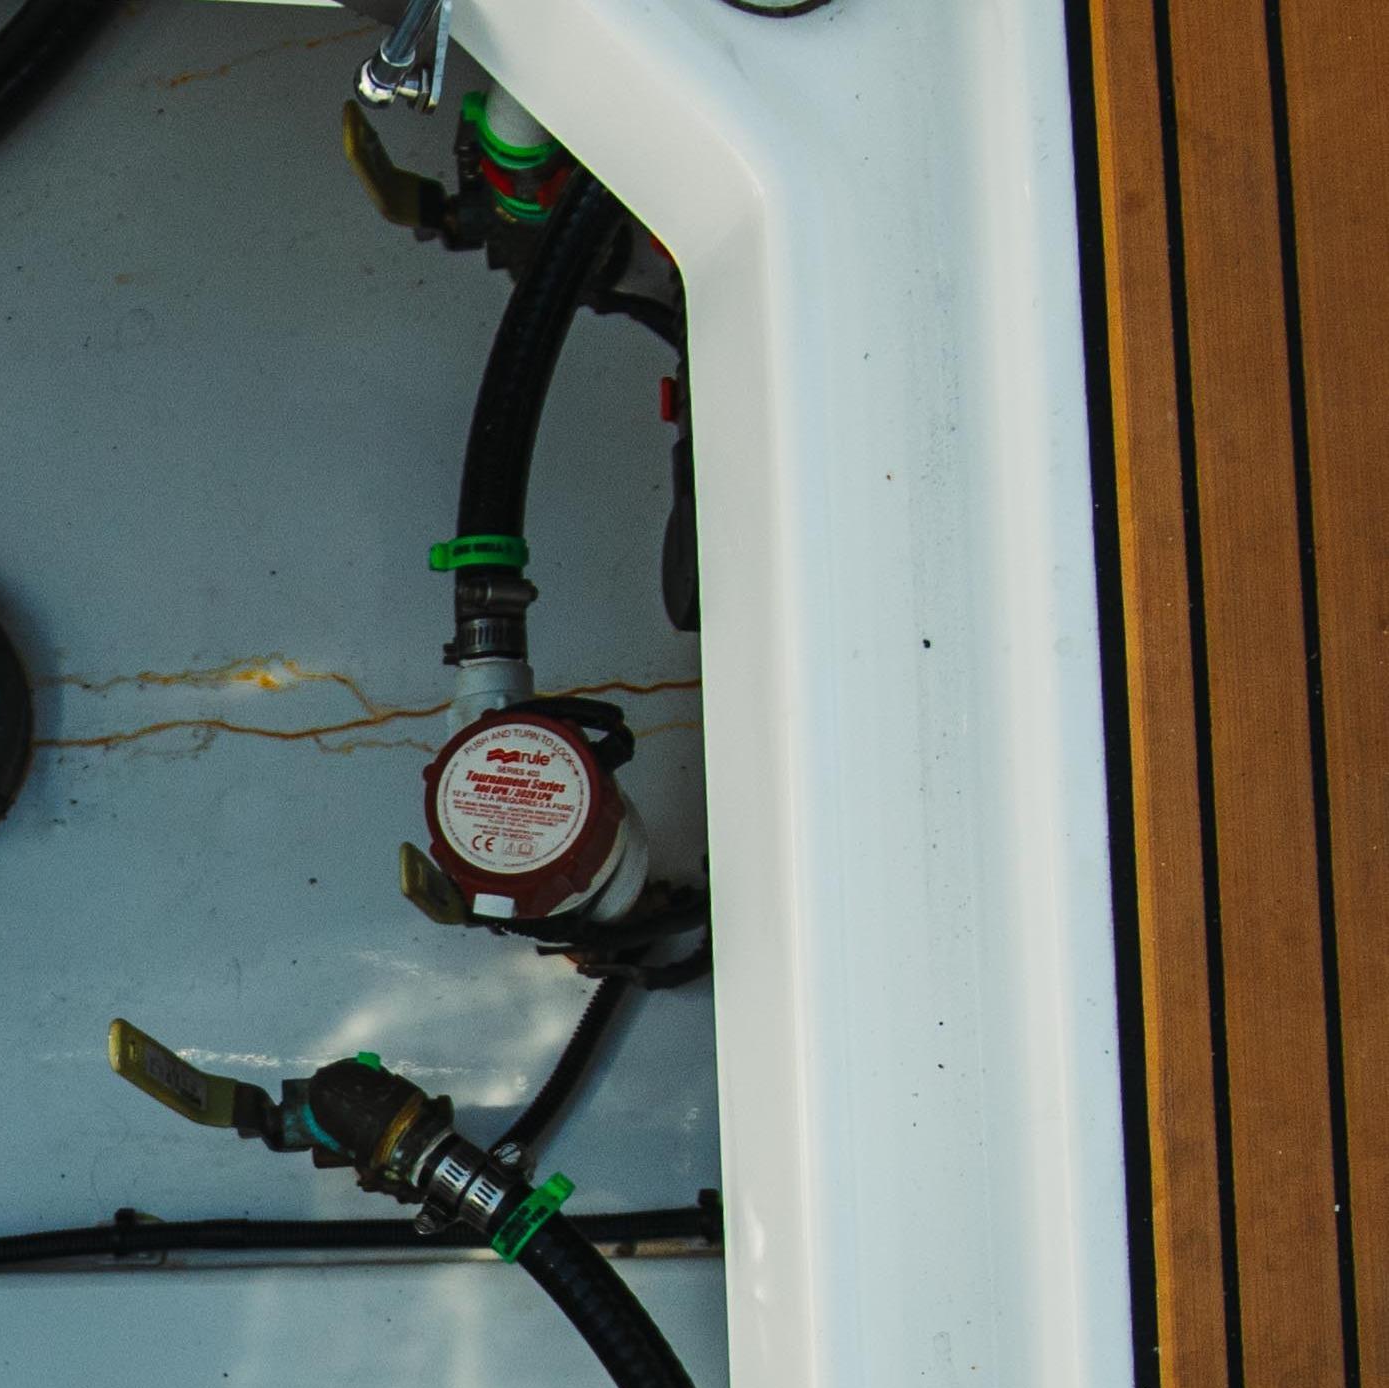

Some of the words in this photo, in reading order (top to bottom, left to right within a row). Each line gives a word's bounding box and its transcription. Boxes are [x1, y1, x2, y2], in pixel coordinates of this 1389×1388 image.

[463, 735, 489, 755] PUSH
[491, 729, 511, 739] AND
[514, 728, 541, 741] TURN
[541, 735, 554, 746] TO
[554, 744, 574, 767] LOCK
[497, 765, 525, 775] SERIES
[466, 770, 531, 787] Tournament
[531, 778, 567, 793] Series
[472, 835, 495, 851] CE
